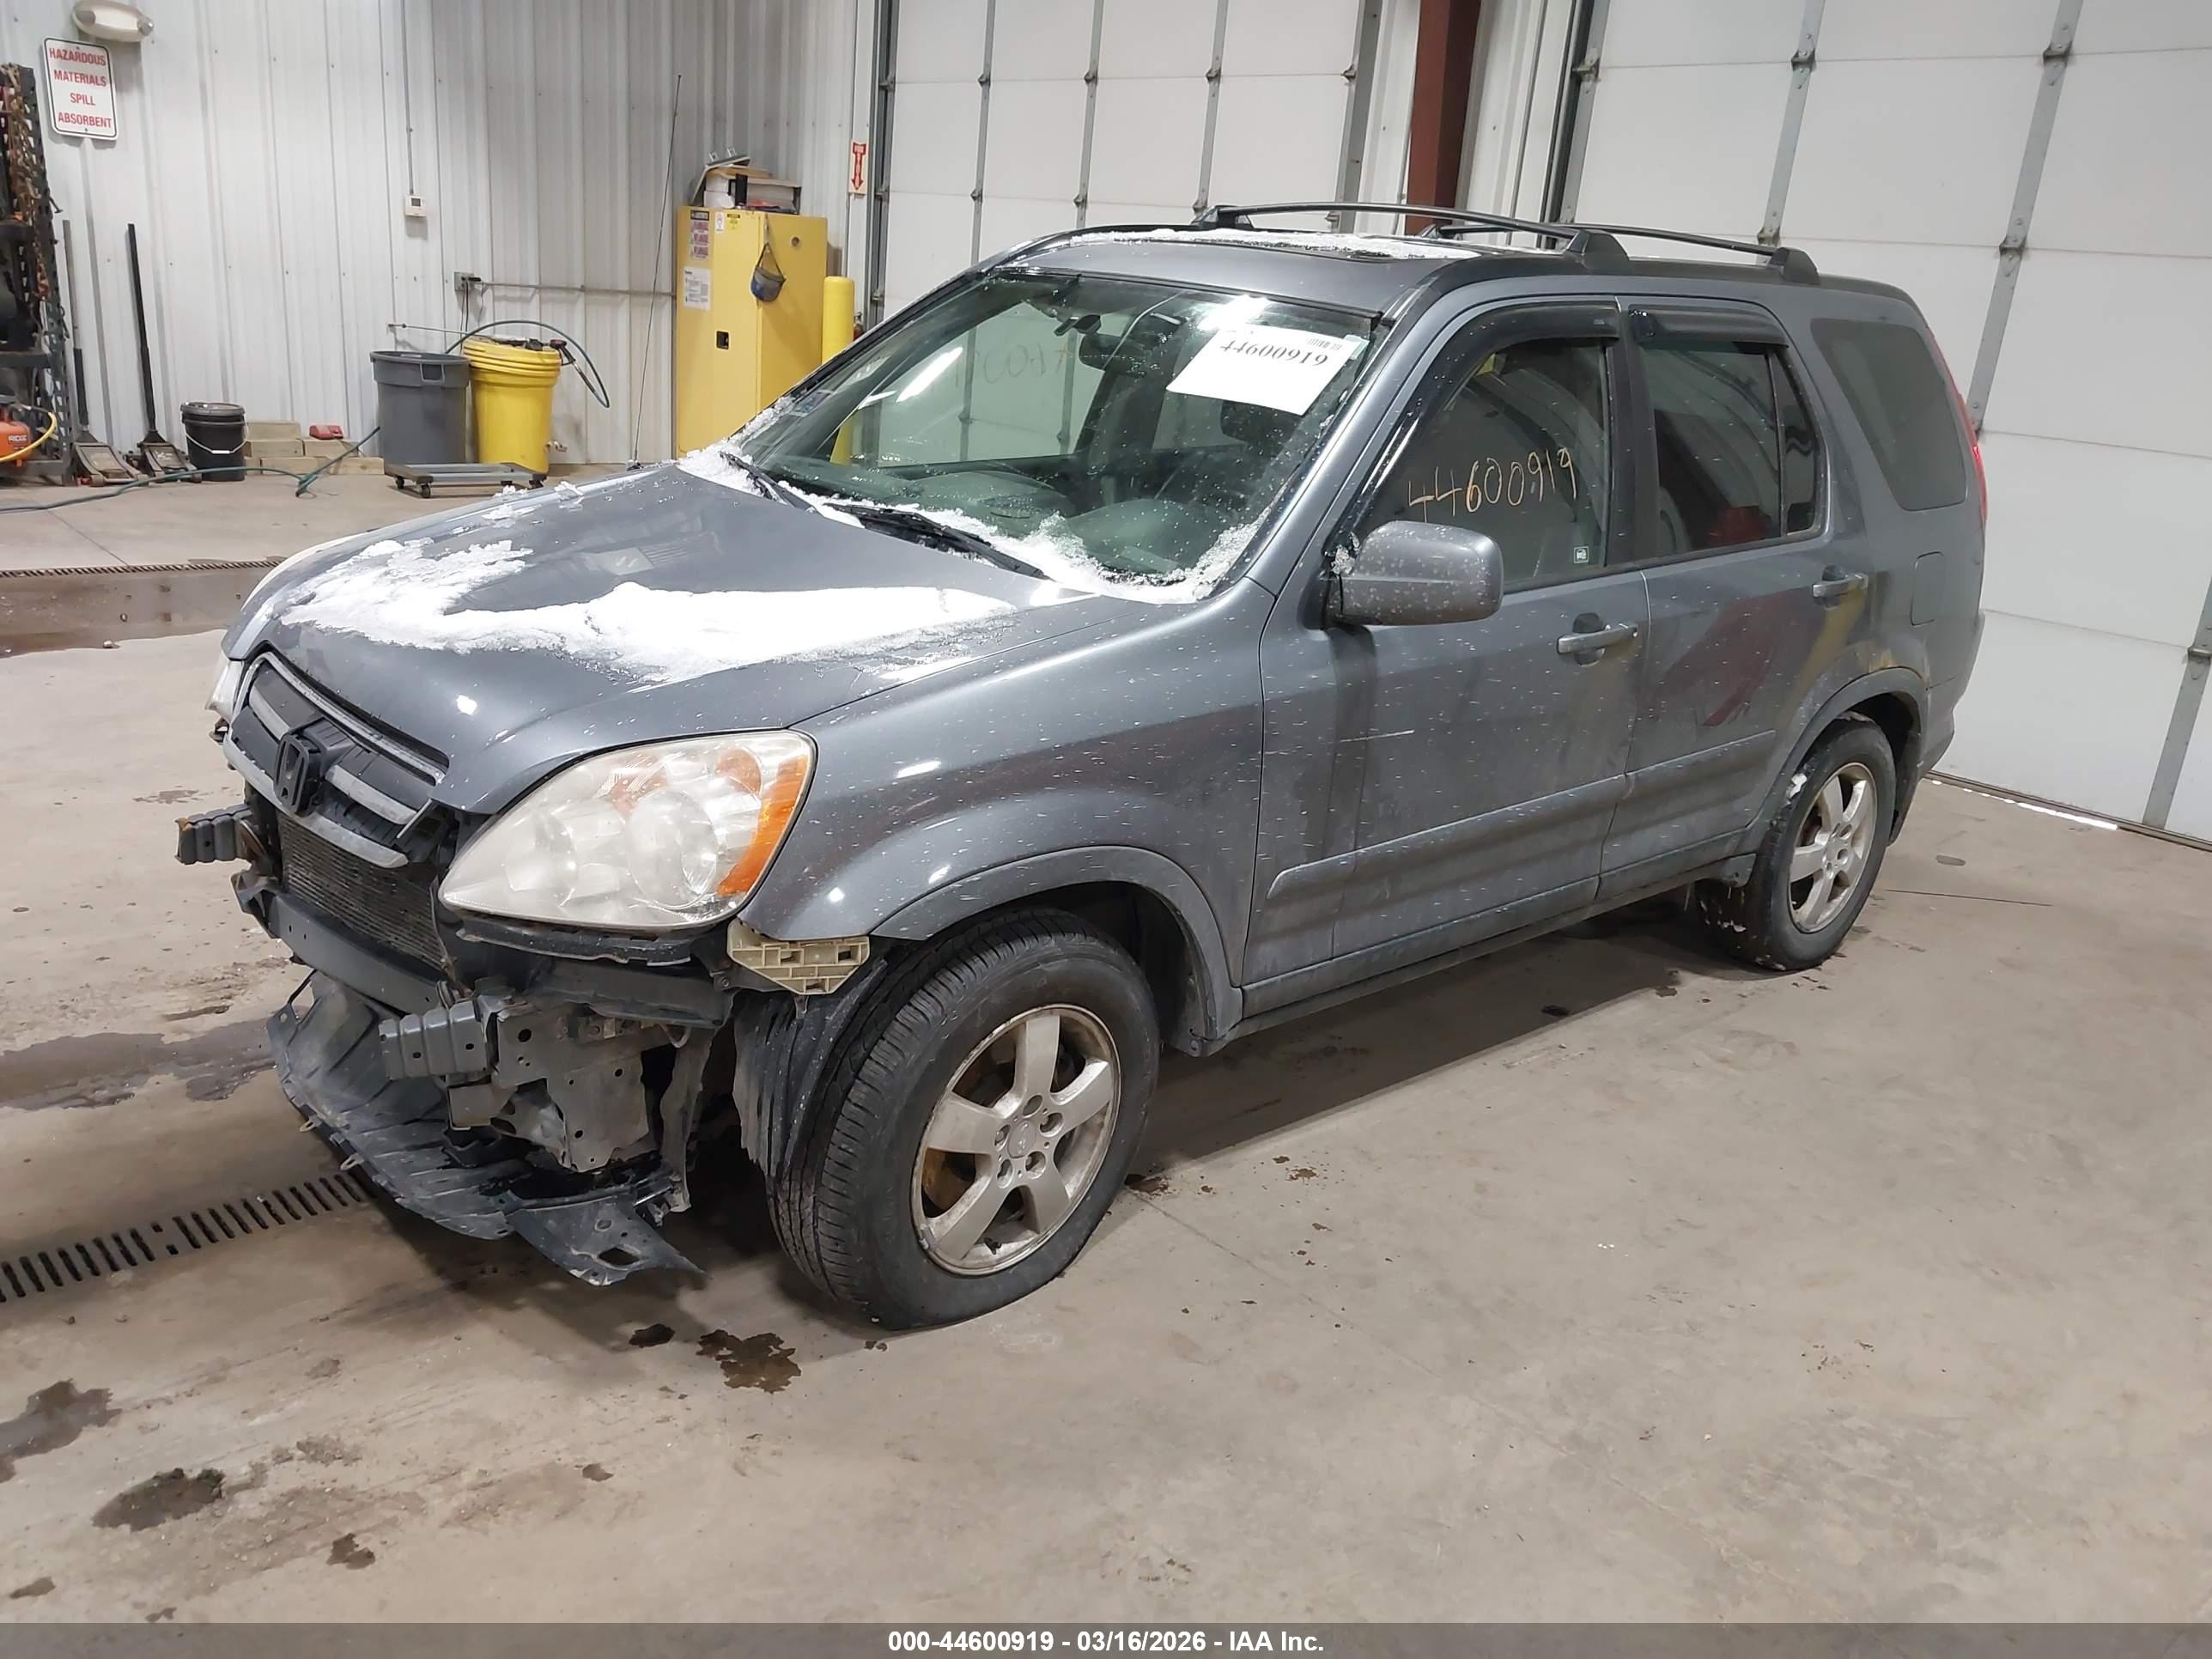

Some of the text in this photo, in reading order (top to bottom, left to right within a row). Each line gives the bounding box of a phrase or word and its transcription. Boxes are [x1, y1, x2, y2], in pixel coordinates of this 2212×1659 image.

[49, 47, 106, 66] HAZARDOUS
[54, 69, 106, 87] MATERIALS
[70, 92, 96, 106] SPILL
[58, 112, 112, 128] ABSORBENT
[1220, 339, 1328, 367] 44600919
[1408, 447, 1577, 522] 44600919
